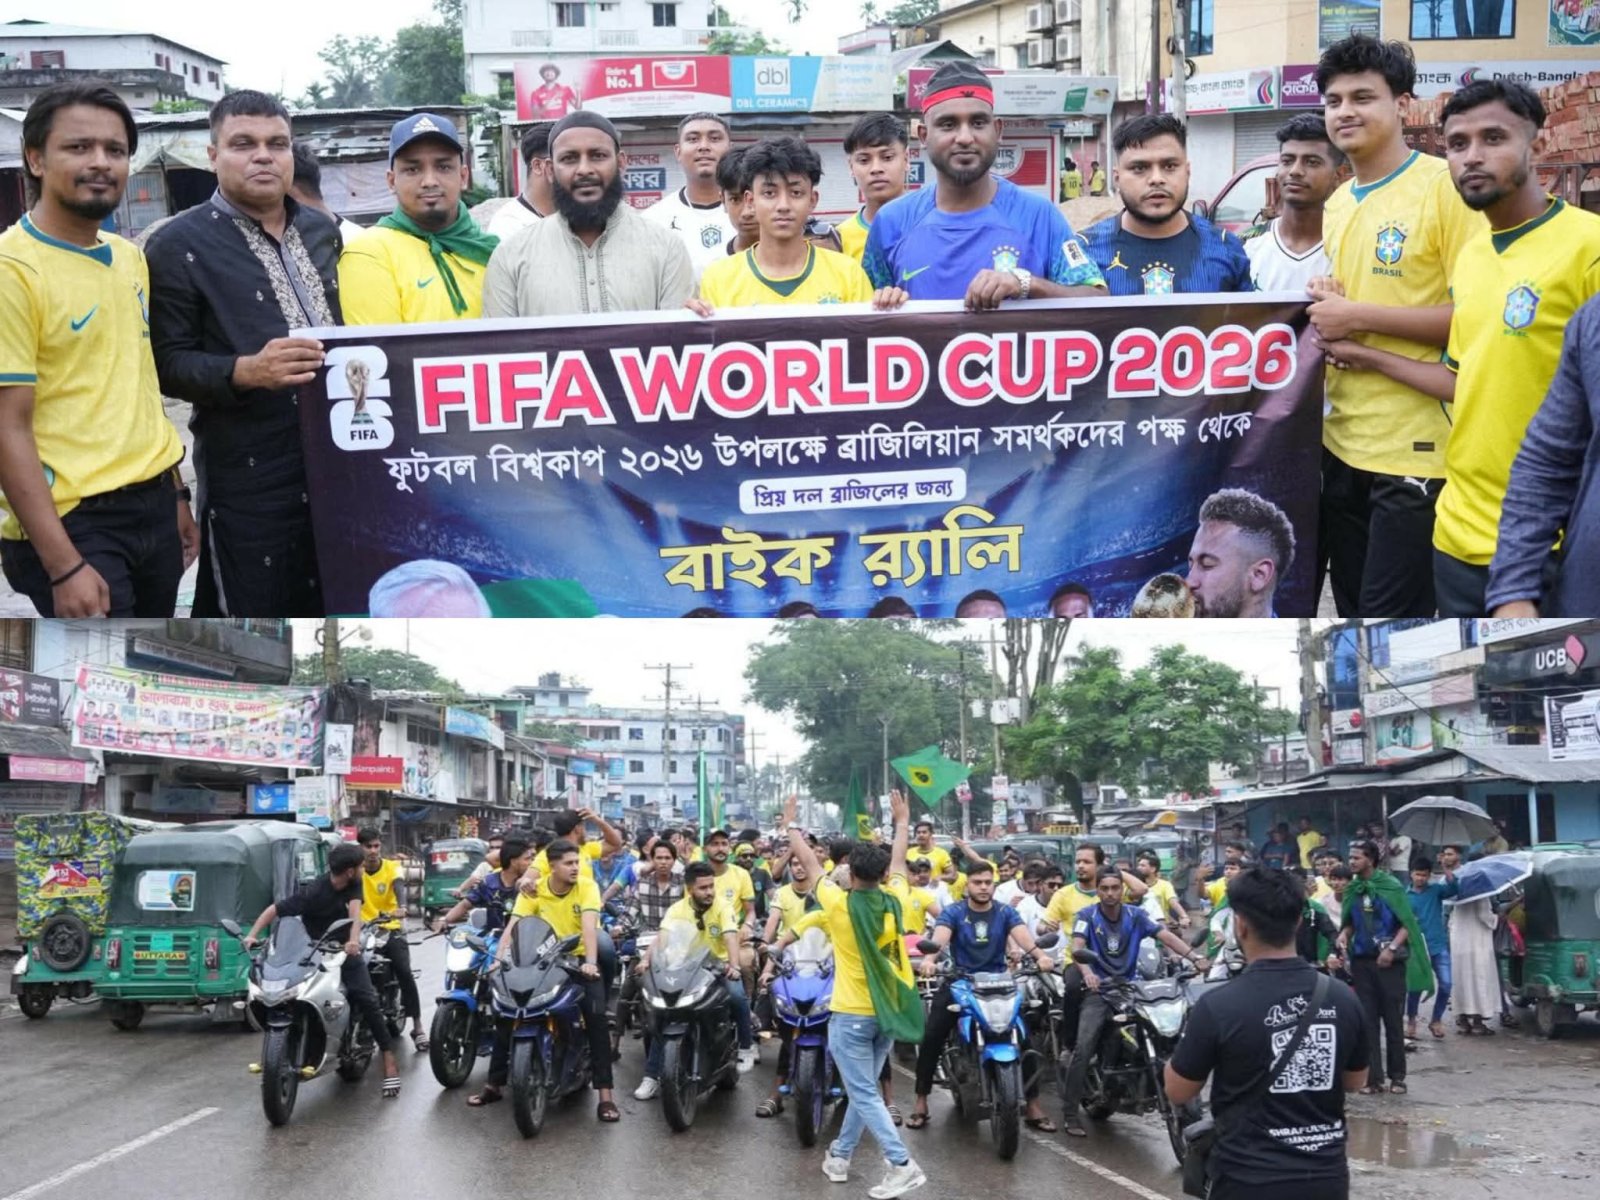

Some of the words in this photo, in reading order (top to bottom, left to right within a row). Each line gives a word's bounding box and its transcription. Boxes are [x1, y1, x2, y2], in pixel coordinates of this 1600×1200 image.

[757, 67, 788, 85] dbl
[736, 98, 752, 108] DBL
[756, 97, 808, 108] CERAMICS
[1372, 266, 1404, 278] BRASIL
[412, 350, 616, 434] FIFA
[610, 335, 930, 426] WORLD
[938, 330, 1103, 408] CUP
[1107, 322, 1298, 400] 2026
[350, 429, 379, 441] FIFA
[383, 448, 478, 493] ফুটবল
[487, 443, 606, 483] বিশ্বকাপ
[619, 443, 703, 477] ২০২৬
[712, 432, 827, 469] উপলক্ষে
[991, 411, 1126, 454] সমর্থকদের
[1137, 414, 1186, 447] পক্ষ
[1198, 410, 1253, 443] থেকে
[753, 484, 786, 507] প্রিয়
[793, 487, 823, 504] দল
[830, 479, 909, 504] ব্রাজিলের
[916, 479, 953, 496] জন্য
[658, 525, 834, 593] বাইক
[1535, 647, 1567, 670] UCB
[141, 951, 178, 960] UTTARA
